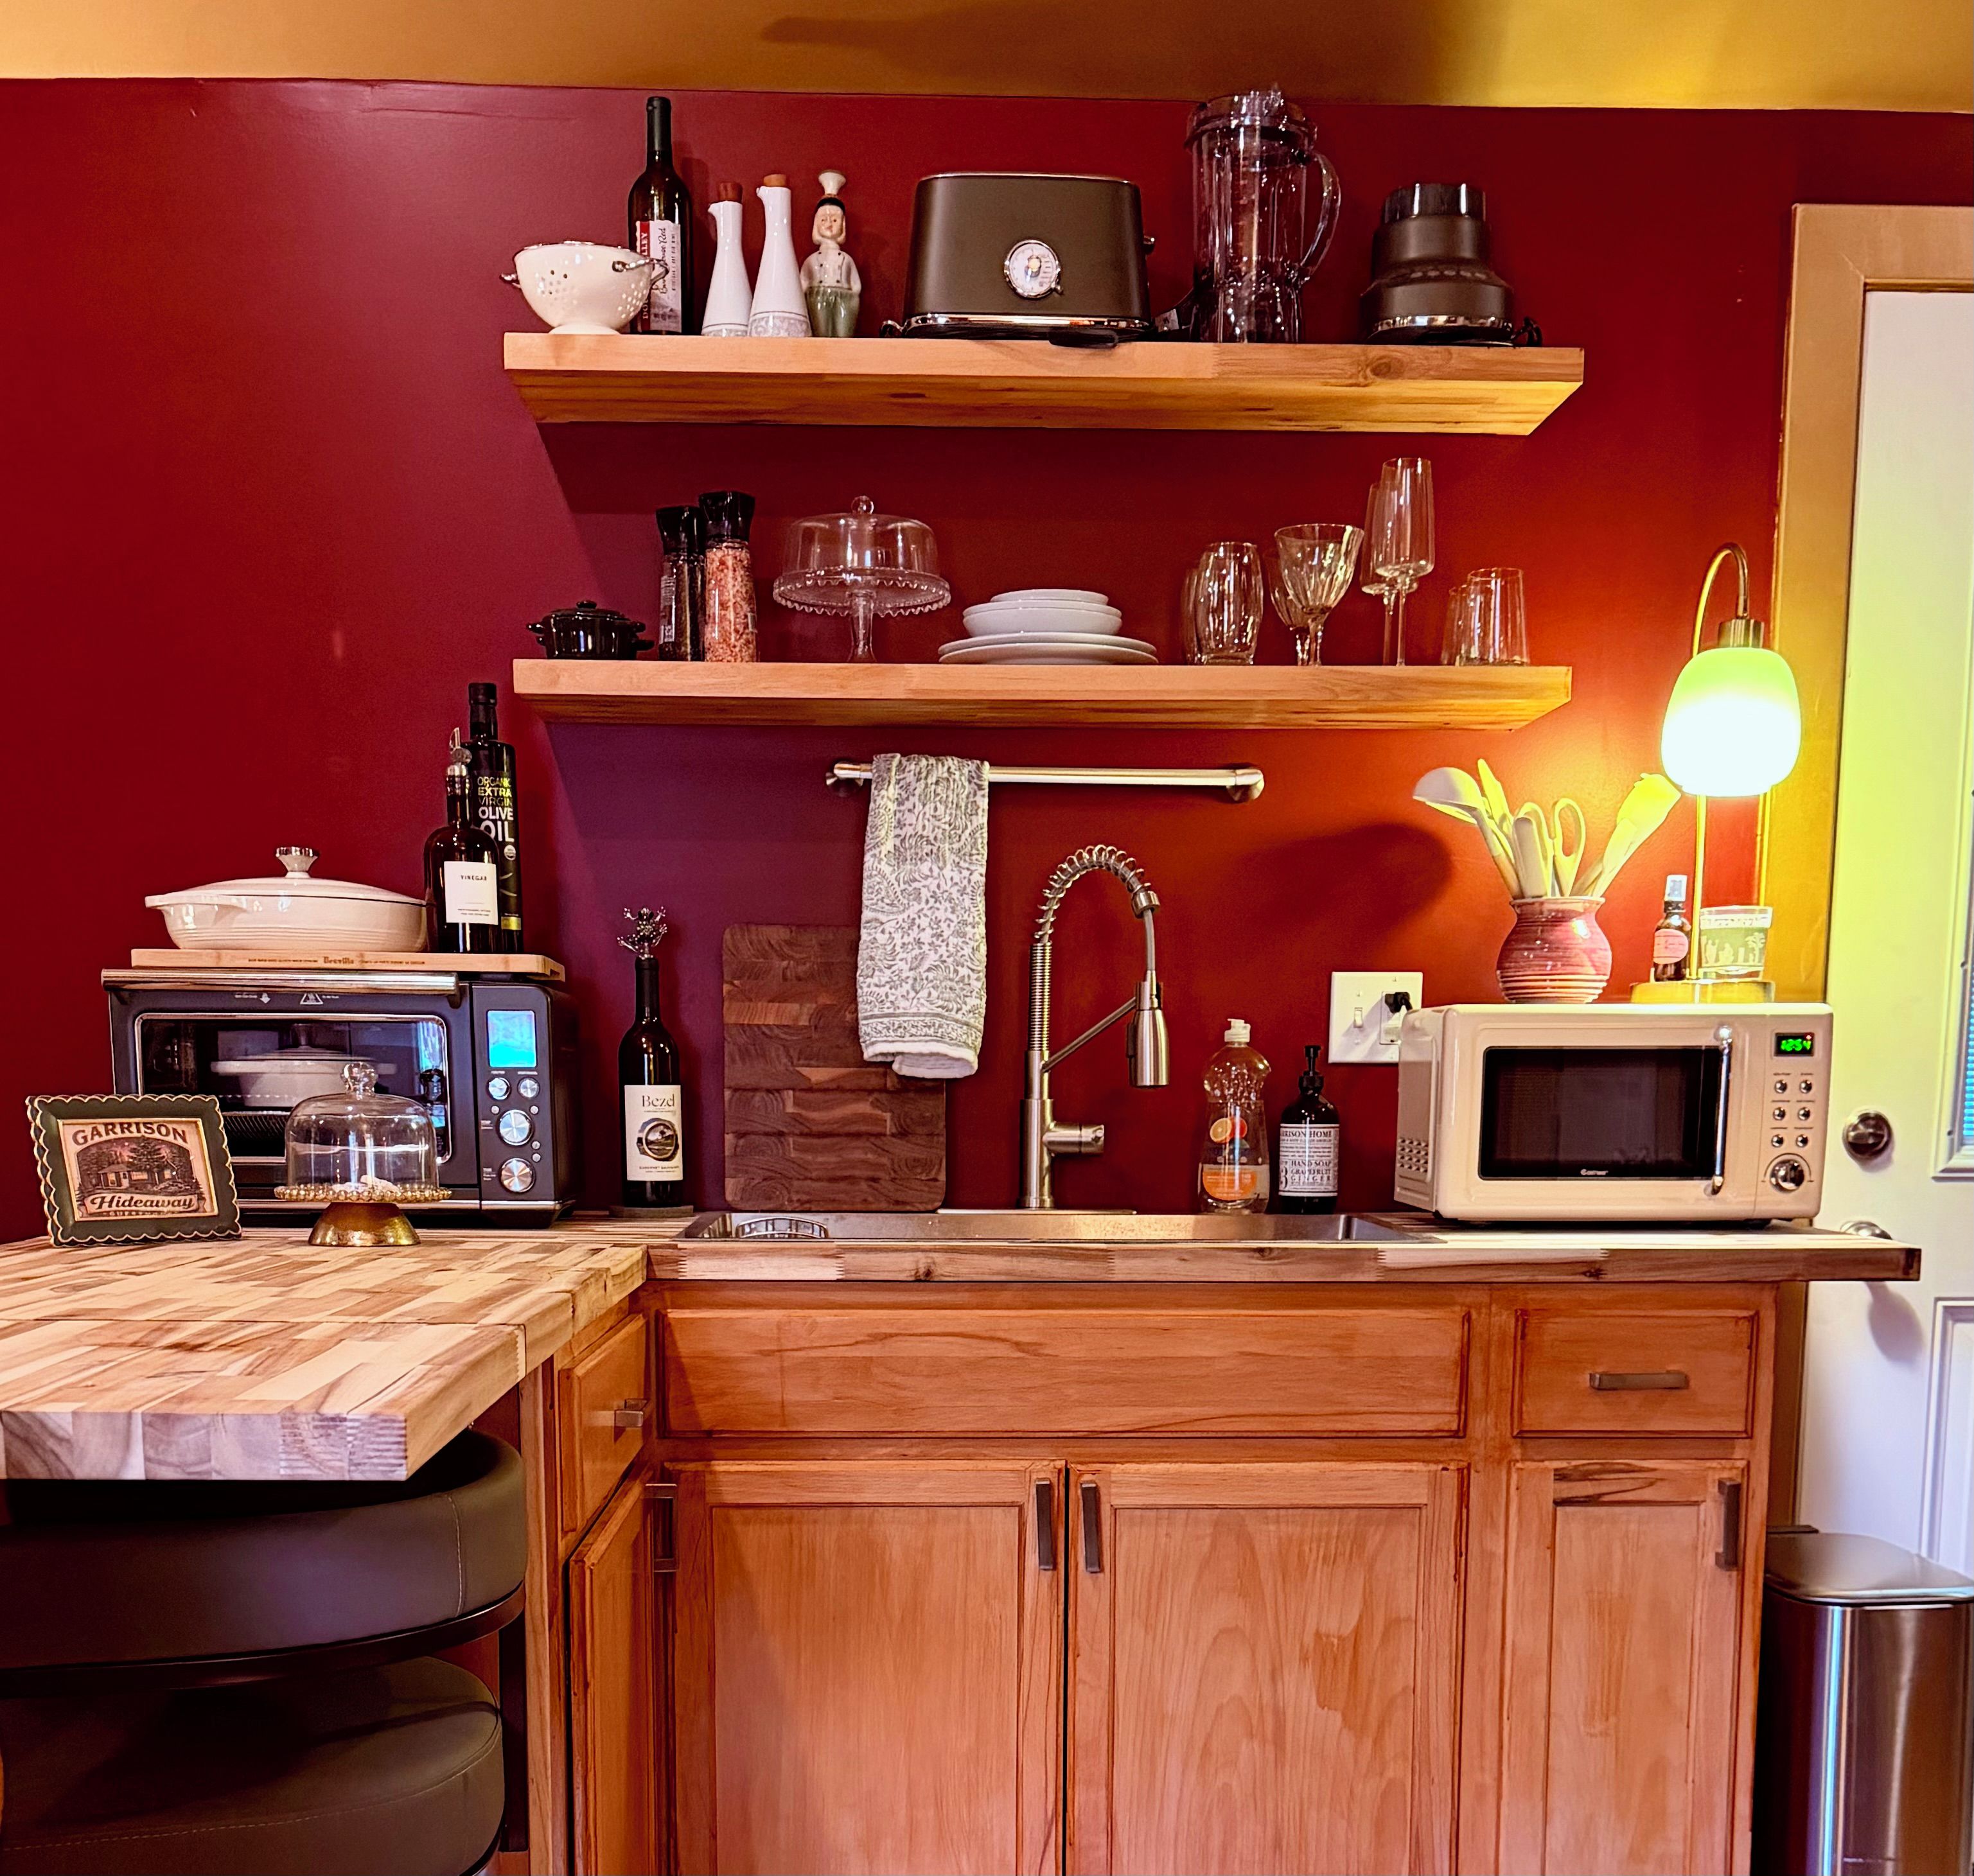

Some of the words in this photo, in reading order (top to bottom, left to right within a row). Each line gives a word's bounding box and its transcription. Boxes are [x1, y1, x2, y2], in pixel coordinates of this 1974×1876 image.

[658, 227, 667, 244] Red
[477, 787, 513, 798] EXTRA
[478, 796, 513, 807] VIRGIN
[478, 806, 514, 821] OLIVE
[480, 820, 515, 842] OIL
[642, 1094, 674, 1107] Bezd
[71, 1122, 188, 1146] GARRISON
[90, 1195, 195, 1210] Hideaway
